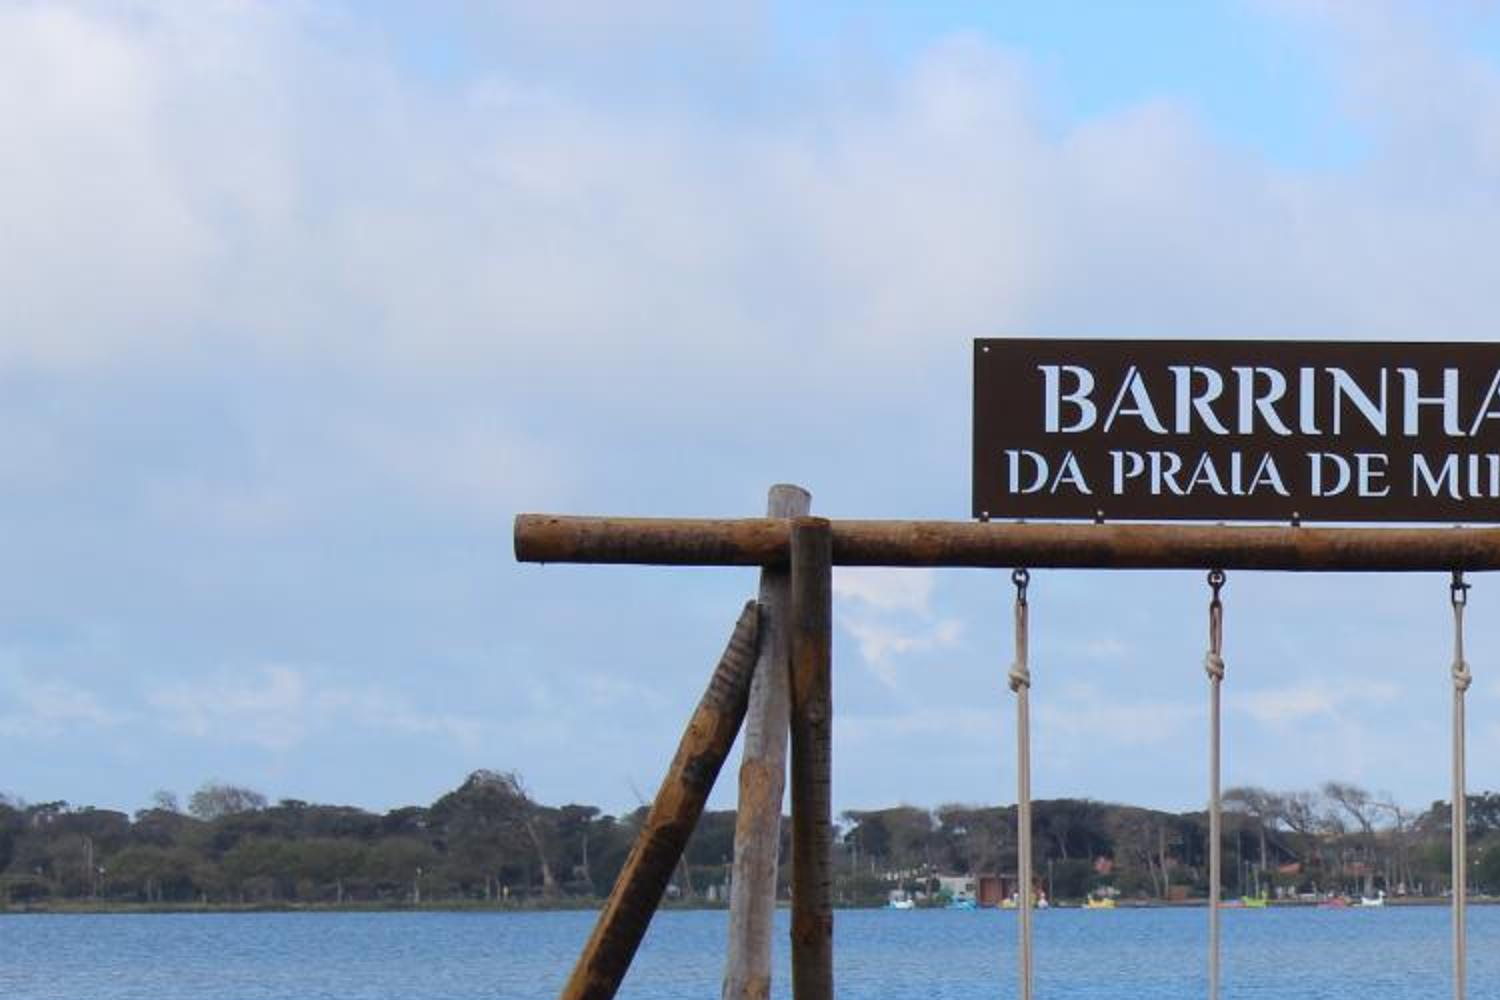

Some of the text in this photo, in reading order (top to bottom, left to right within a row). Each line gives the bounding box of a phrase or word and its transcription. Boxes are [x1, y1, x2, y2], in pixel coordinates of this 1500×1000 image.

[1005, 450, 1093, 495] DA
[1110, 450, 1291, 497] PRAIA
[1307, 453, 1390, 497] DE
